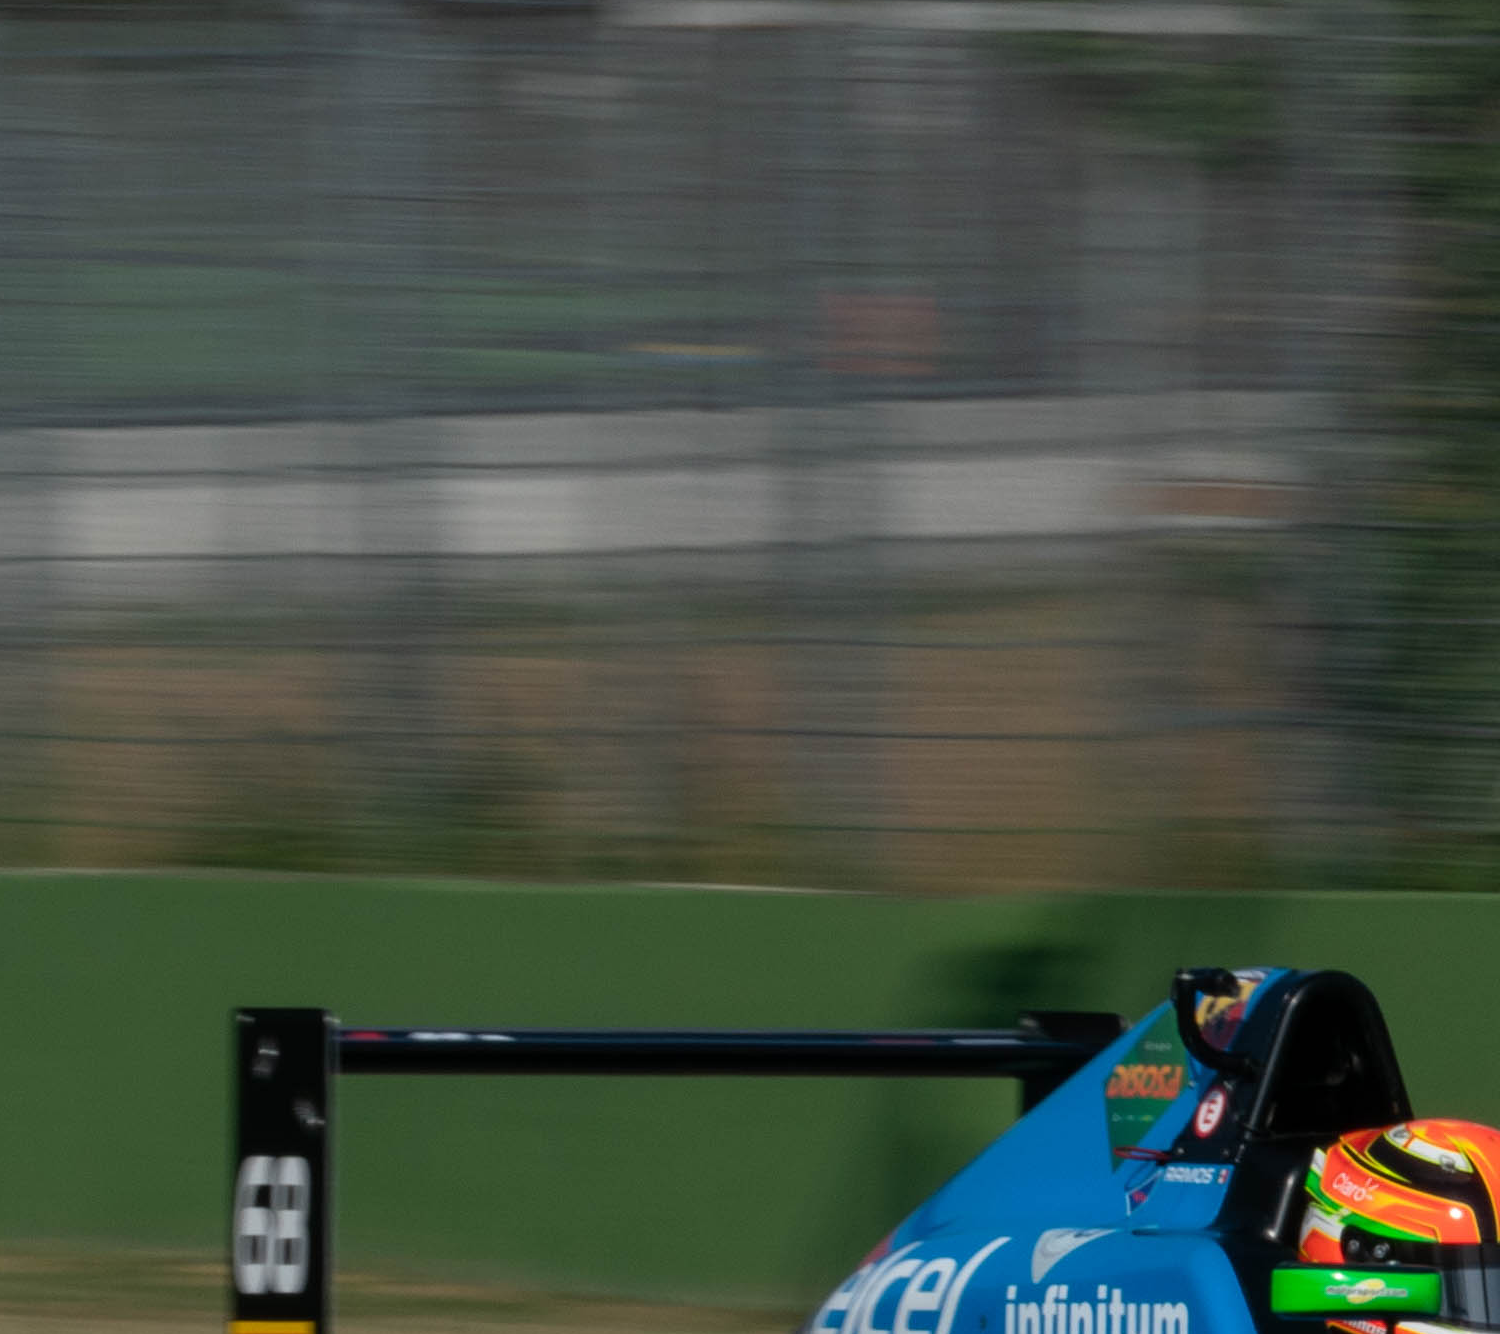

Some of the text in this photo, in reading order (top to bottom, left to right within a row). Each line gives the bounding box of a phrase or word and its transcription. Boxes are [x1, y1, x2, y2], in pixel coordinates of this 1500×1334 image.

[1164, 1166, 1215, 1184] RAMOS
[1332, 1172, 1367, 1202] Claro
[234, 1155, 311, 1294] 68
